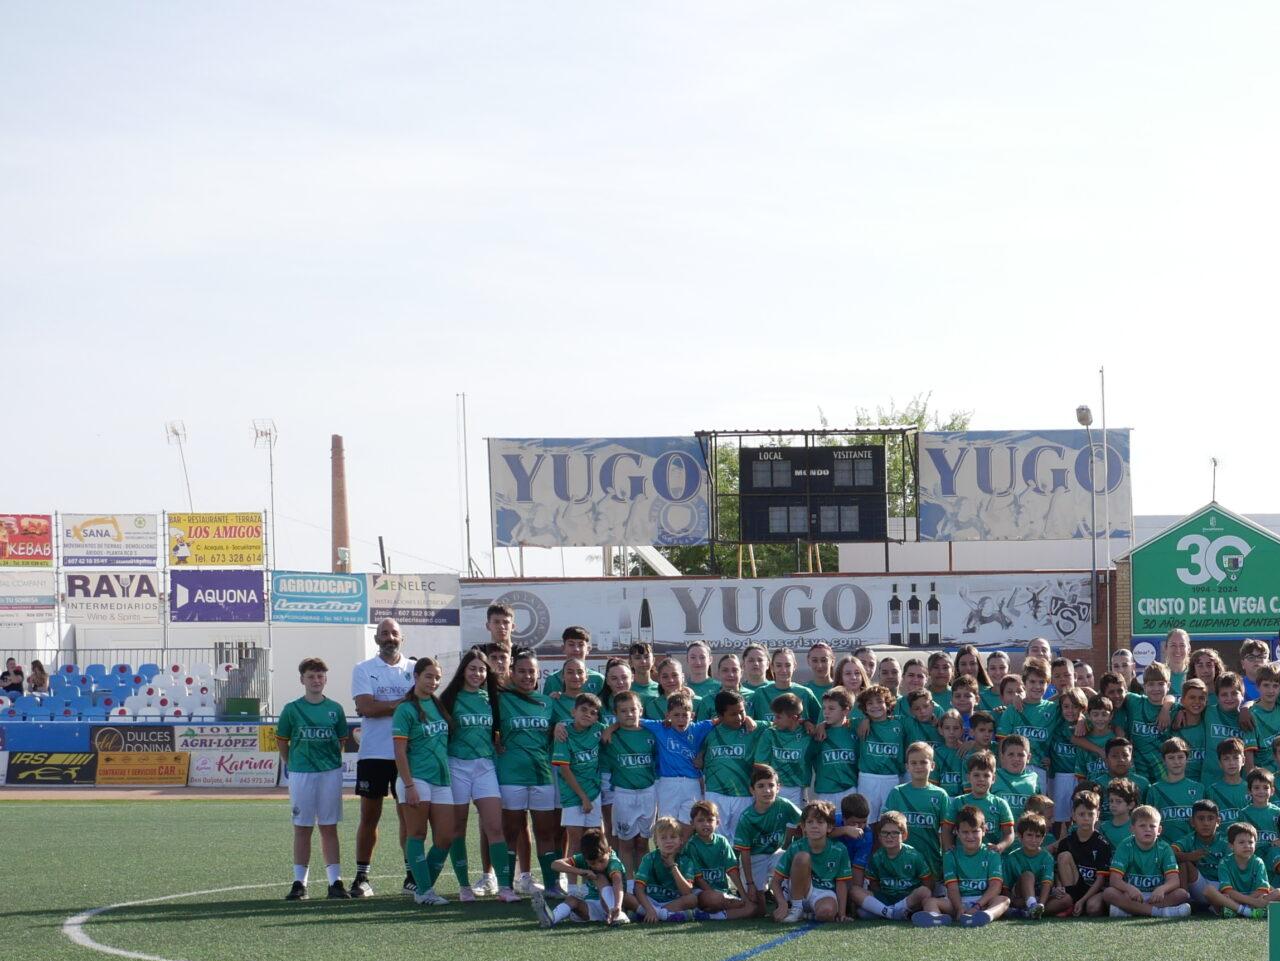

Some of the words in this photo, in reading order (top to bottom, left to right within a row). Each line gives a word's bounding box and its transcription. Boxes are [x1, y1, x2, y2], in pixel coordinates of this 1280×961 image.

[759, 452, 783, 460] LOCAL
[833, 450, 872, 459] VISITANTE
[925, 443, 1124, 497] YUGO
[502, 451, 702, 503] YUGO
[188, 515, 228, 523] RESTAURANTE
[188, 526, 210, 538] LOS
[213, 525, 262, 538] AMIGOS
[8, 542, 52, 556] KEBAB
[211, 554, 226, 562] 673
[229, 554, 244, 562] 328
[247, 554, 262, 562] 614
[67, 574, 157, 597] RAYA
[279, 578, 357, 594] AGROZOCAPI
[391, 581, 436, 591] ENELEC
[194, 589, 258, 603] AQUONA
[67, 602, 158, 610] INTERMEDIARIOS
[274, 599, 362, 613] Landini
[671, 583, 873, 636] YUGO
[1138, 597, 1185, 615] CRISTO
[1189, 597, 1206, 615] DE
[1210, 597, 1227, 614] LA
[1229, 596, 1266, 614] VEGA
[1142, 619, 1156, 629] 30
[1159, 617, 1186, 628] AÑOS
[1190, 618, 1240, 628] CUIDANDO
[463, 716, 493, 728] YUGO
[513, 717, 548, 729] YUGO
[127, 732, 170, 742] DULCES
[301, 728, 333, 739] YUGO
[1016, 728, 1047, 739] YUGO
[1212, 725, 1245, 737] YUGO
[181, 736, 258, 748] AGRI-LÓPEZ
[712, 745, 744, 756] YUGO
[867, 745, 898, 755] YUGO
[11, 753, 49, 764] IRS
[620, 754, 651, 766] YUGO
[824, 751, 855, 762] YUGO
[216, 754, 275, 775] Karina
[158, 766, 177, 776] CAR
[1163, 808, 1192, 819] YUGO
[1127, 875, 1160, 886] YUGO
